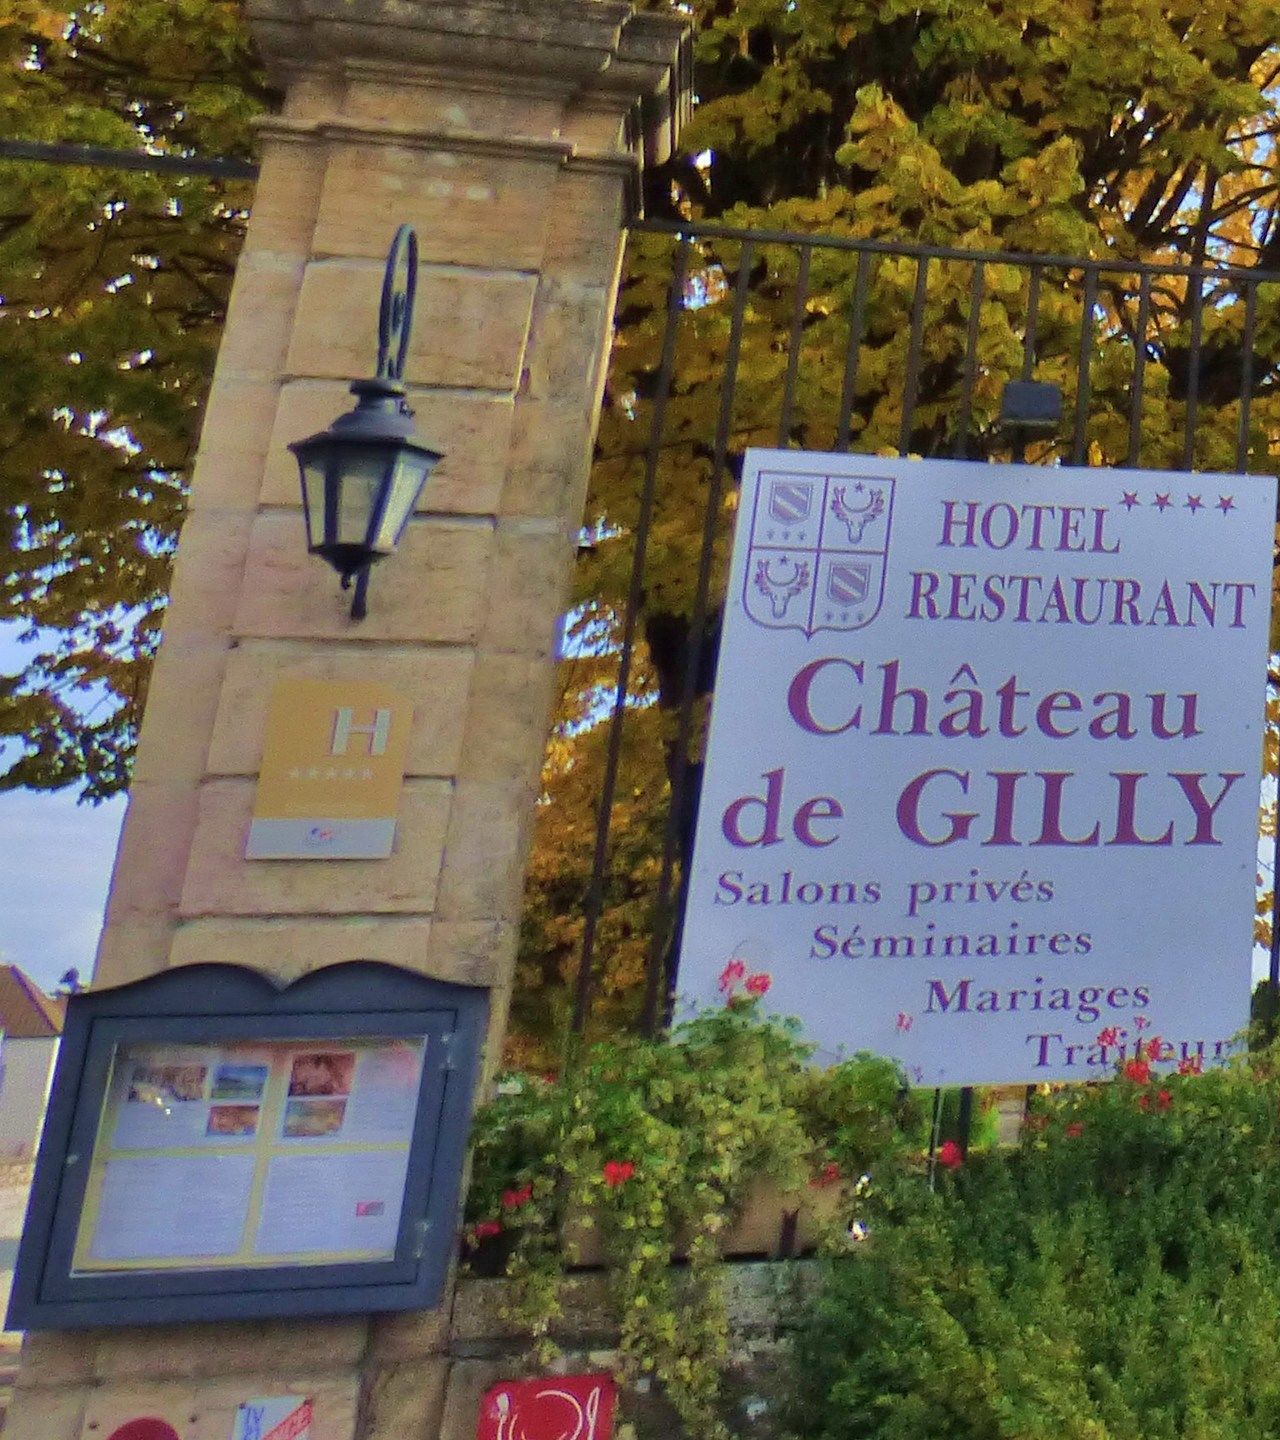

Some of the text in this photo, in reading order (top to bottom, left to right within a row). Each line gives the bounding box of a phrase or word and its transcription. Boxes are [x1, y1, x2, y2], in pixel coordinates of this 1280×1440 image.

[937, 499, 1121, 554] HOTEL
[904, 571, 1256, 629] RESTAURANT
[786, 657, 1203, 740] Château
[330, 707, 392, 756] H
[720, 768, 1245, 849] de GILLY
[713, 869, 1055, 918] Salons privés
[809, 922, 1093, 960] Séminaires
[924, 977, 1150, 1023] Mariages
